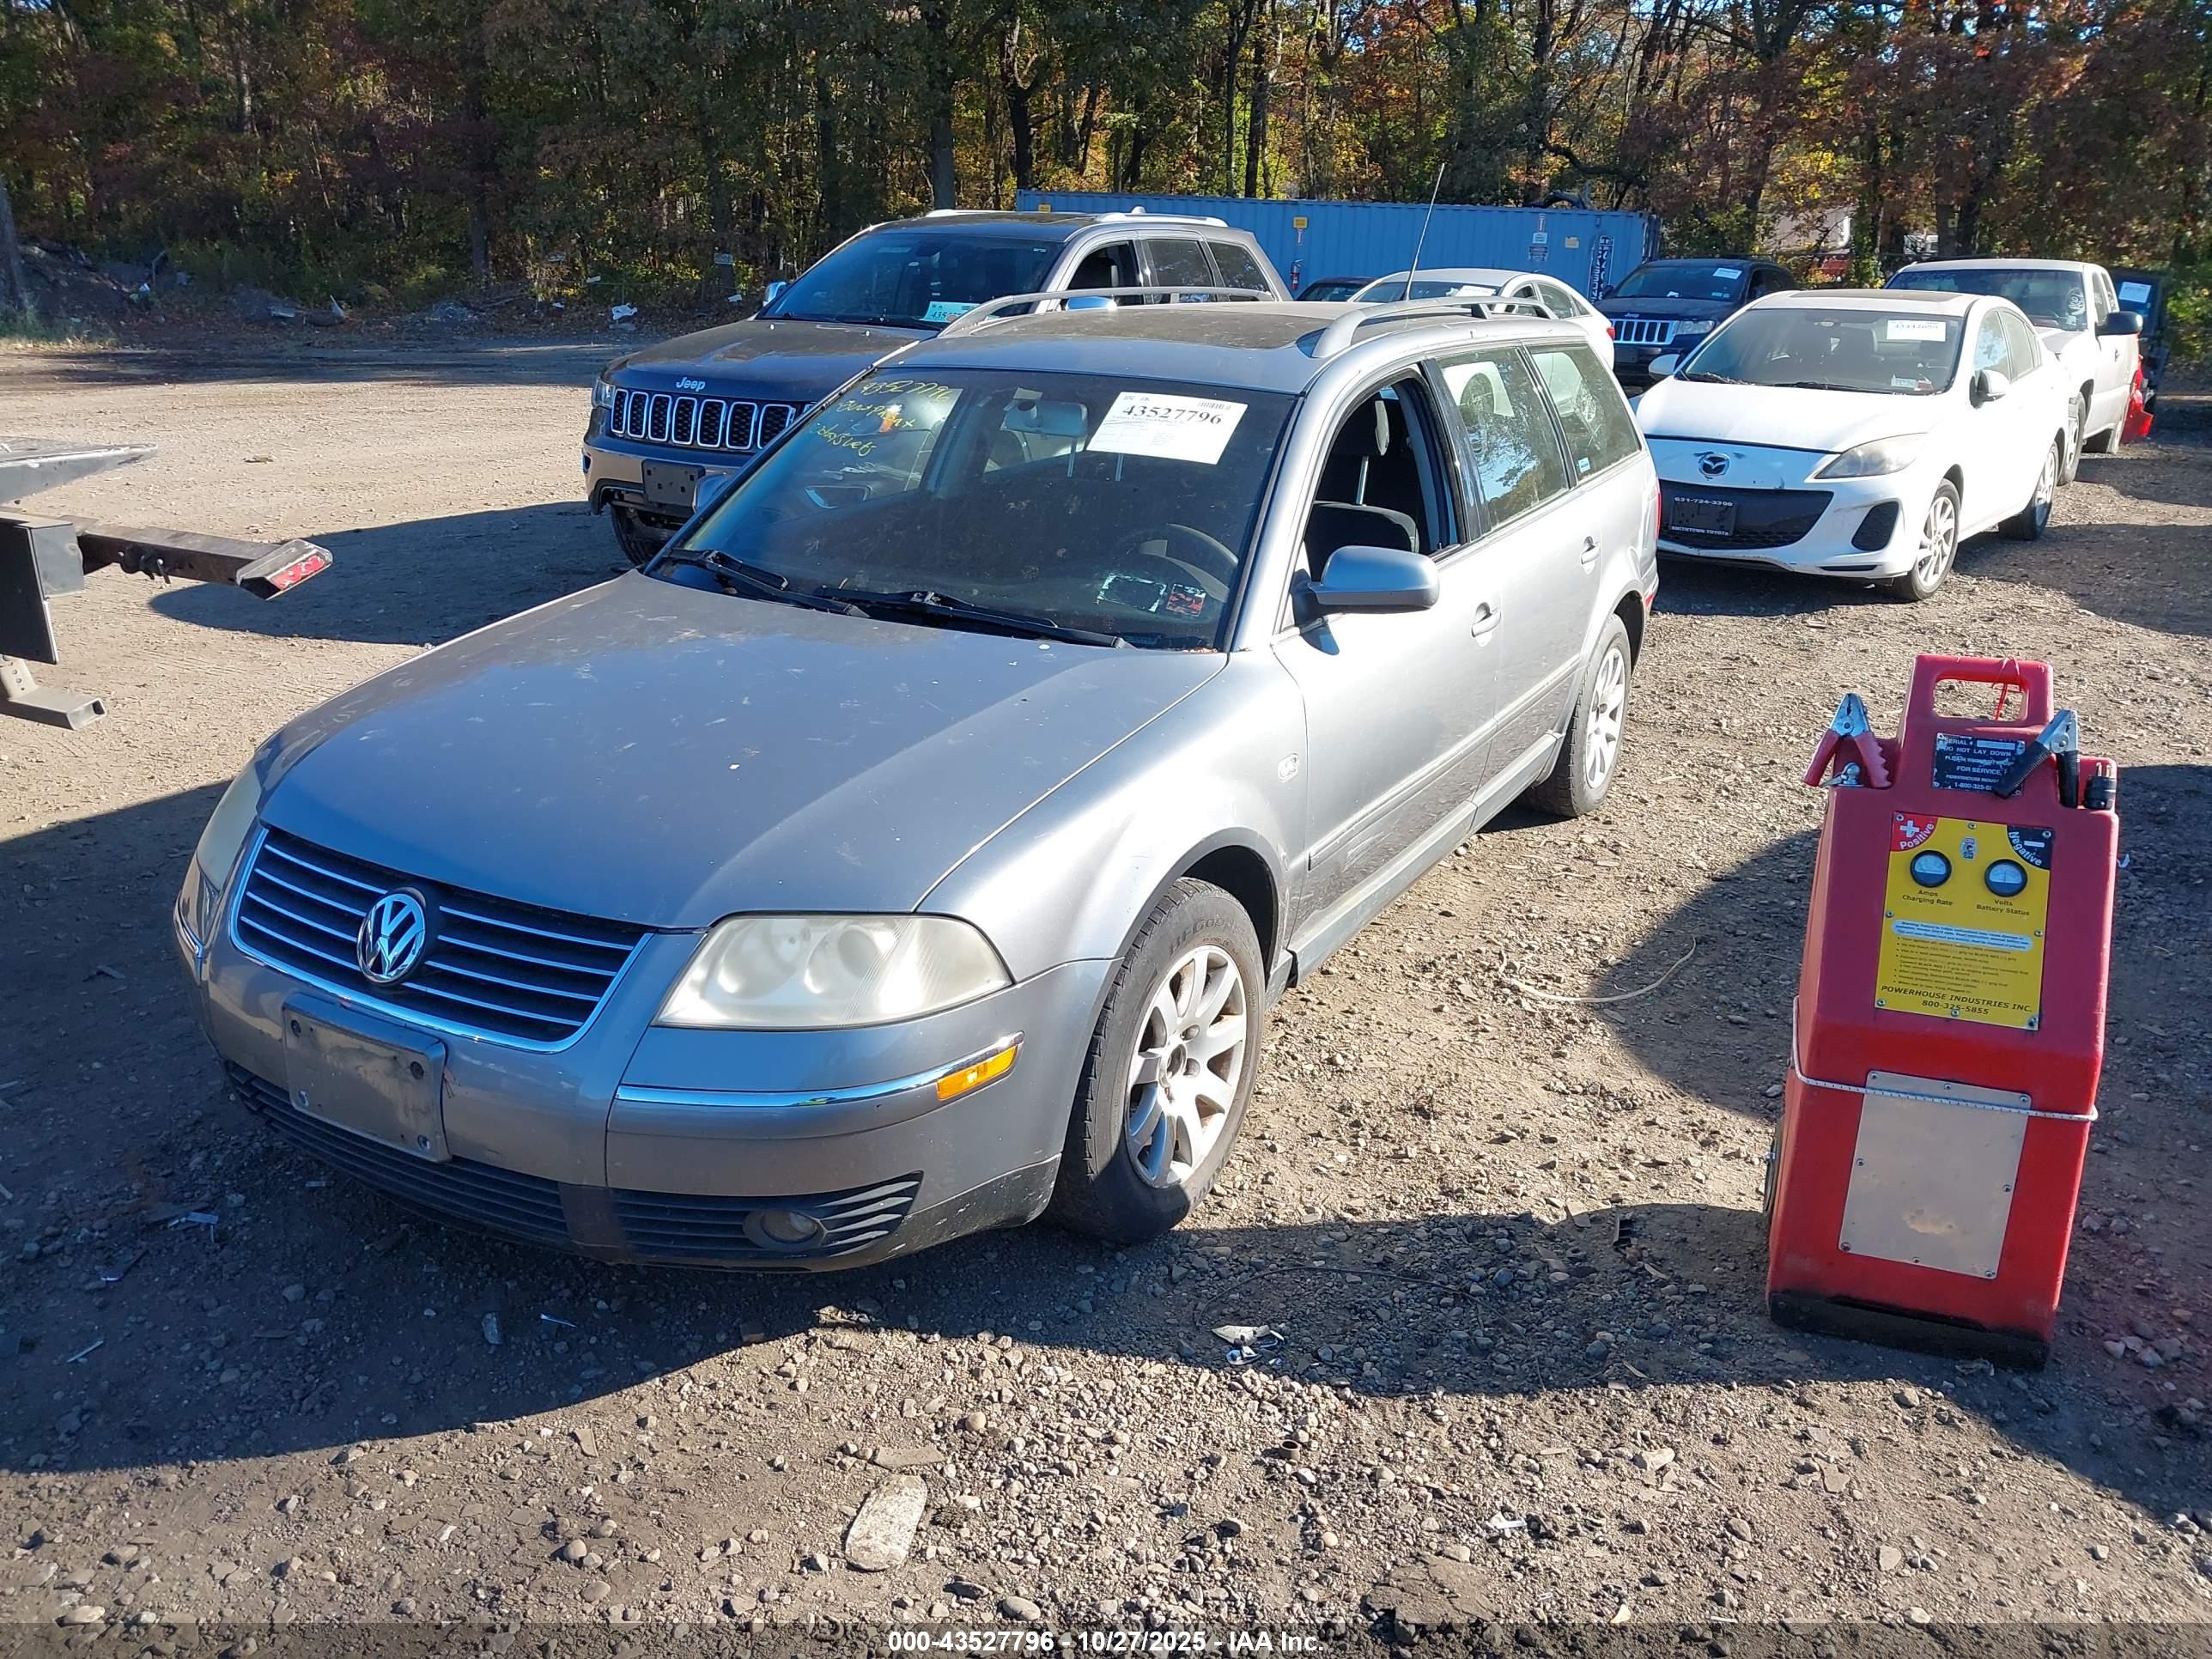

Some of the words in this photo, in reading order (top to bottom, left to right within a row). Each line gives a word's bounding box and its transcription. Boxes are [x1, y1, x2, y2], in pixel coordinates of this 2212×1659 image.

[676, 376, 706, 392] Jeep
[1122, 404, 1223, 424] 43527796
[1899, 823, 1935, 850] Positive
[2008, 831, 2042, 866] Negative
[1902, 894, 1935, 904] Charging
[1977, 904, 2003, 913] Battery
[1881, 985, 1947, 1000] POWERHOUSE
[1949, 994, 2009, 1009] INDUSTRIES
[2012, 1003, 2033, 1012] INC.
[1922, 1000, 1990, 1015] 800-325-5855
